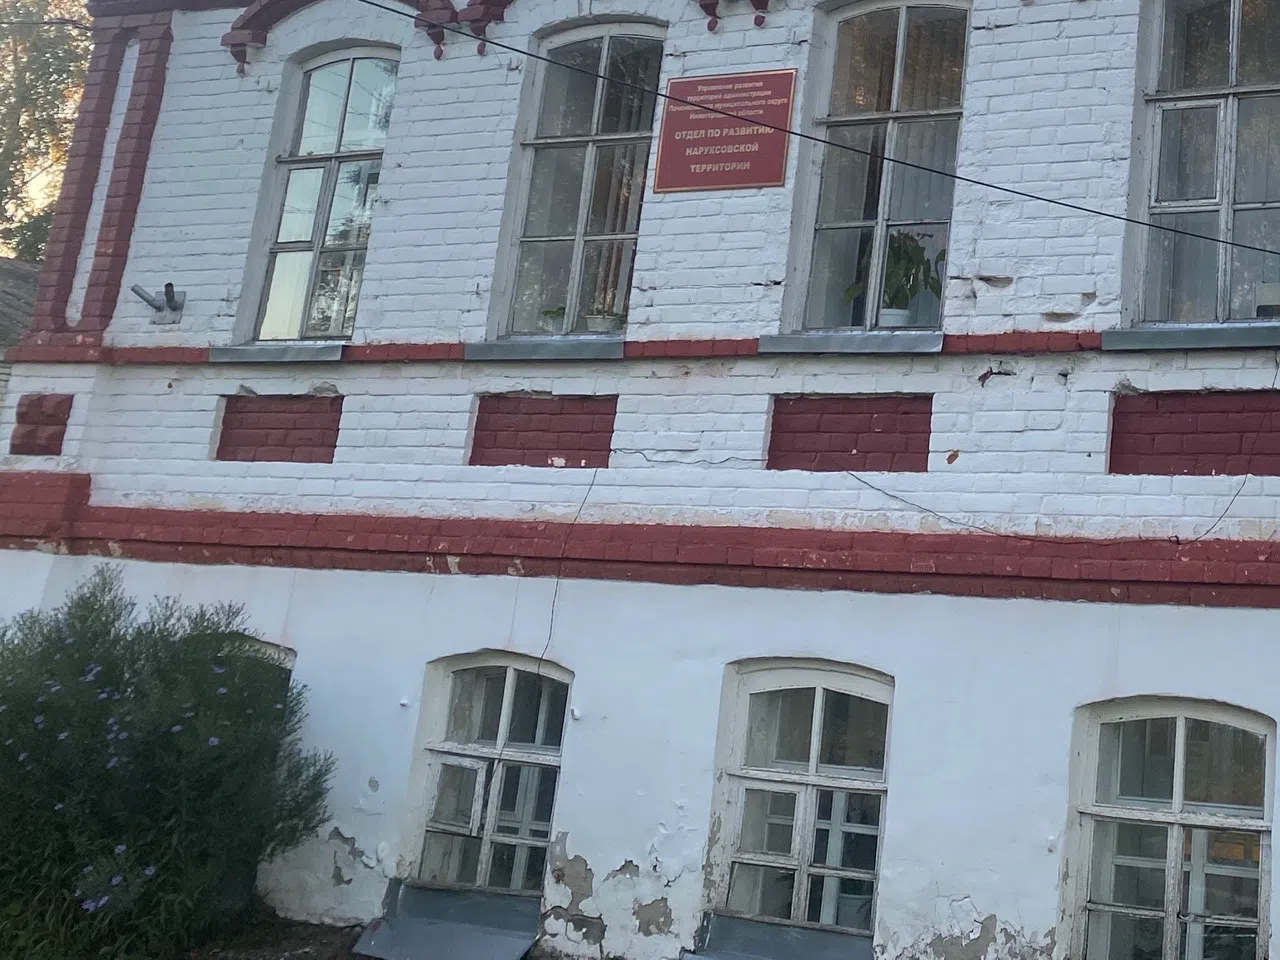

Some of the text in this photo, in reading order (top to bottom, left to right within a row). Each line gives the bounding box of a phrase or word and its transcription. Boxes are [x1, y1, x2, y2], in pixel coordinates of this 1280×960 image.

[734, 81, 764, 89] развития
[723, 90, 772, 99] администрации
[738, 108, 764, 116] области
[674, 125, 775, 140] ОТДЕЛ ПО РАЗВИТИЮ
[685, 141, 759, 156] НАРУКСОВСКОЙ
[689, 161, 751, 173] ТЕРРИТОРИИ
